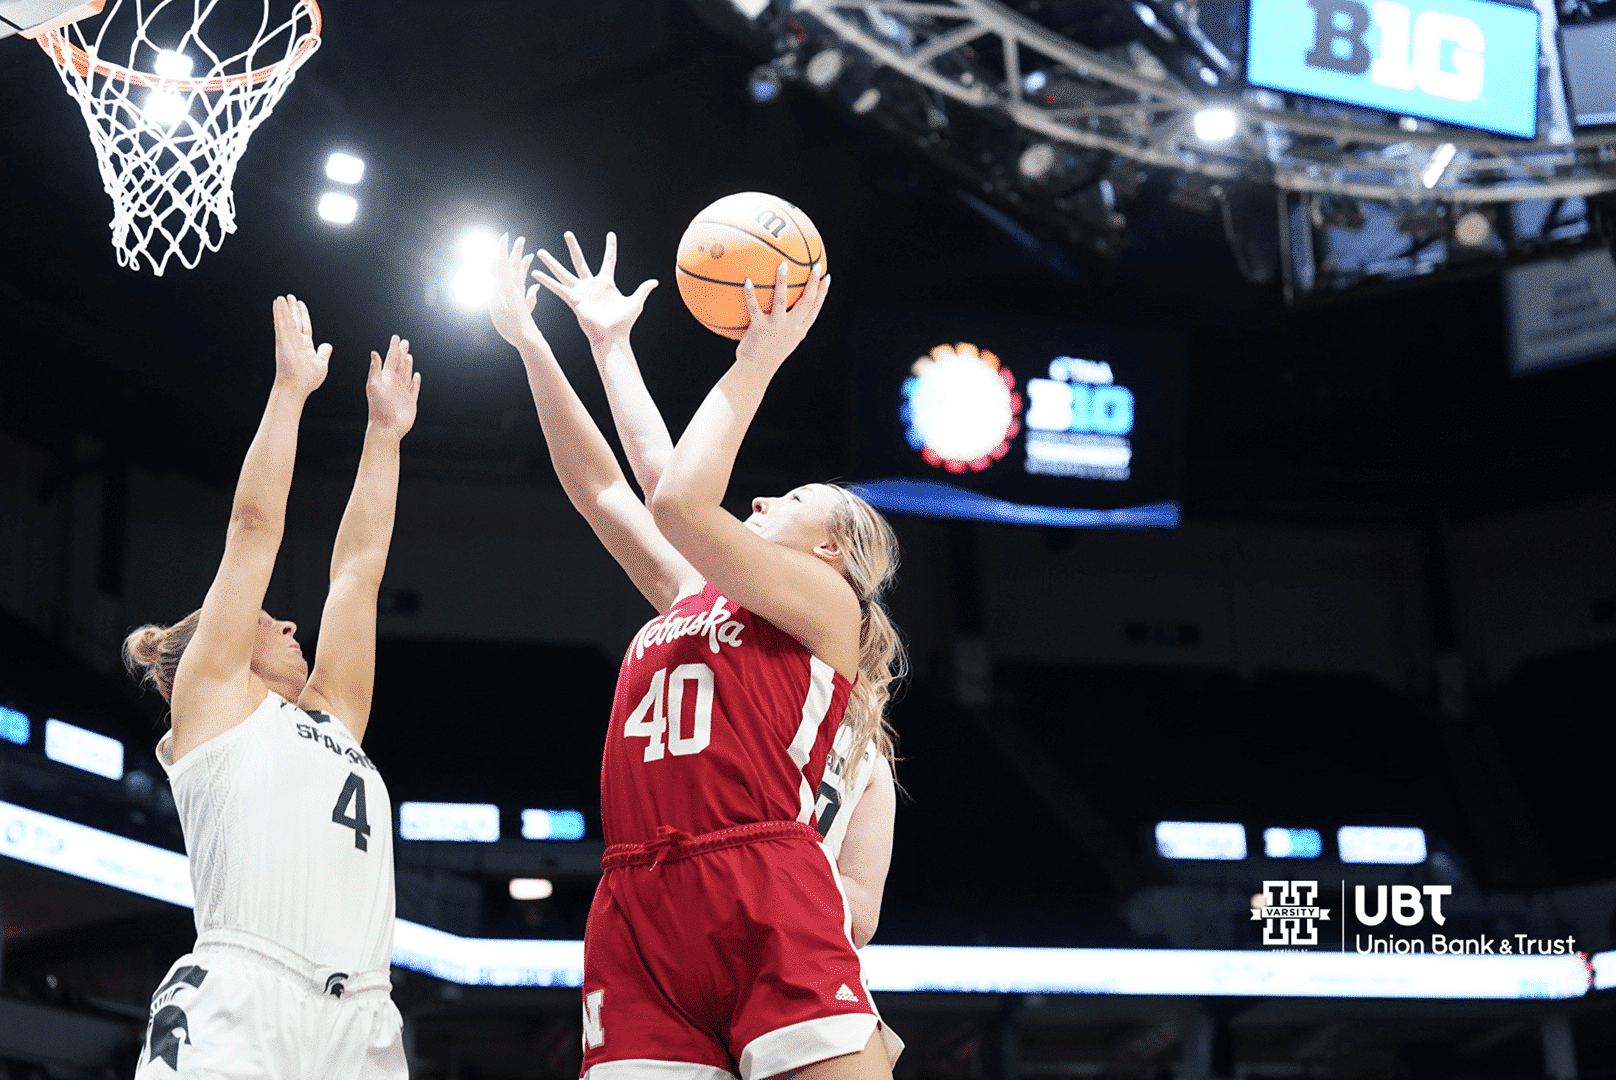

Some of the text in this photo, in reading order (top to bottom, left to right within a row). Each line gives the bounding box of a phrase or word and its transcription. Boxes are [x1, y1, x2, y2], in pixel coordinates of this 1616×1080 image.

[627, 596, 745, 666] Nebraska
[623, 663, 715, 763] 40
[332, 771, 371, 853] 4
